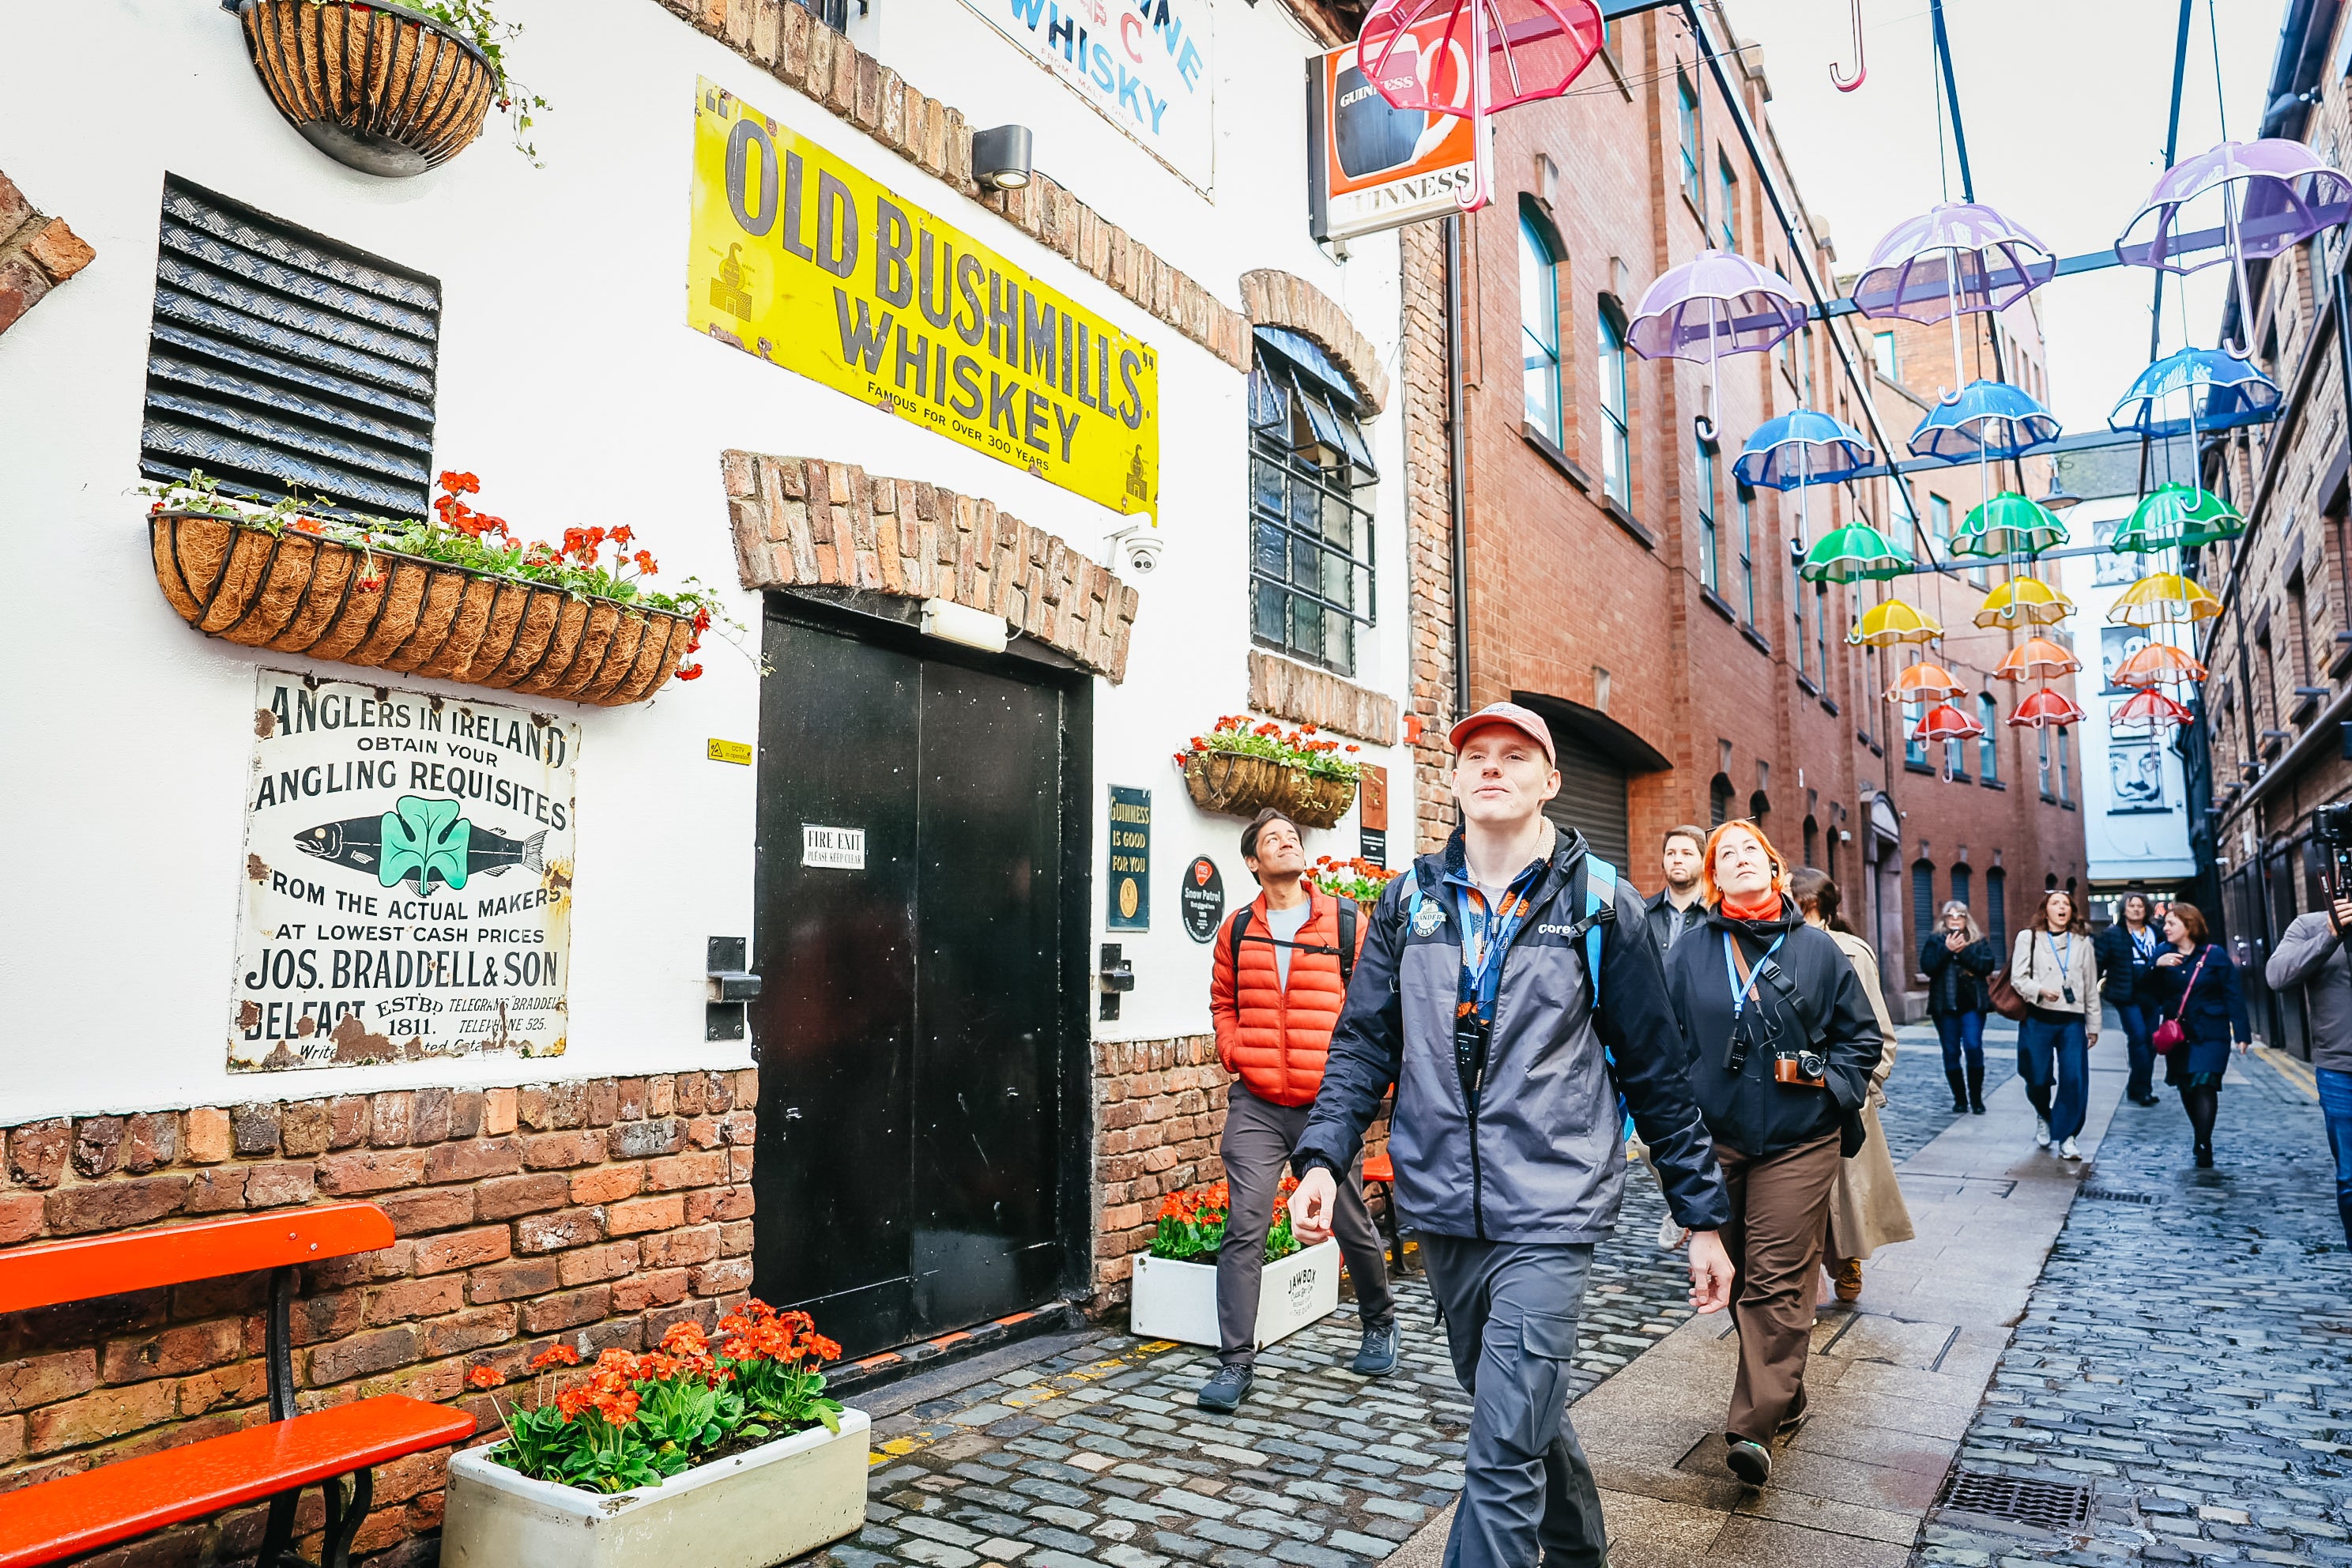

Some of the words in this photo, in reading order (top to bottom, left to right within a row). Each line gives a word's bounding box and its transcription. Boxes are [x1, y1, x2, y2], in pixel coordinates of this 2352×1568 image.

[1041, 47, 1069, 75] FROM
[1347, 168, 1470, 213] UINNESS
[832, 286, 1081, 464] WHISKEY
[868, 381, 917, 413] FAMOUS
[924, 408, 946, 426] FOR
[952, 420, 982, 442] OVER
[988, 435, 1011, 454] 300
[271, 685, 410, 737] ANGLERS
[420, 706, 443, 733] IN
[452, 711, 566, 770] IRELAND
[357, 737, 437, 754] OBTAIN
[447, 742, 498, 767] YOUR
[731, 744, 744, 753] CCTV
[254, 760, 396, 812] ANGLING
[409, 761, 567, 831] REQUISITES
[1110, 796, 1150, 825] GUINNESS
[808, 830, 833, 849] FIRE
[838, 832, 861, 850] EXIT
[1112, 830, 1121, 846] IS
[1123, 831, 1146, 849] GOOD
[808, 850, 828, 862] PLEASE
[830, 852, 844, 863] KEEP
[845, 853, 861, 865] CLEAR
[1112, 855, 1128, 872] FOR
[1129, 856, 1145, 873] YOU
[259, 868, 325, 906] ROM
[336, 890, 378, 917] THE
[388, 901, 468, 921] ACTUAL
[478, 888, 561, 918] MAKERS
[1185, 887, 1202, 899] Snow
[1203, 889, 1221, 902] Patrol
[275, 923, 306, 940] AT
[318, 925, 405, 941] LOWEST
[413, 927, 468, 943] CASH
[477, 929, 545, 944] PRICES
[1538, 924, 1571, 935] core
[245, 948, 324, 990] JOS.
[332, 949, 481, 989] BRADDELL
[483, 956, 499, 988] &
[503, 951, 559, 987] SON
[459, 1018, 523, 1034] TELEPHNE
[300, 1044, 336, 1060] Write
[1288, 1268, 1317, 1295] JAWBOX
